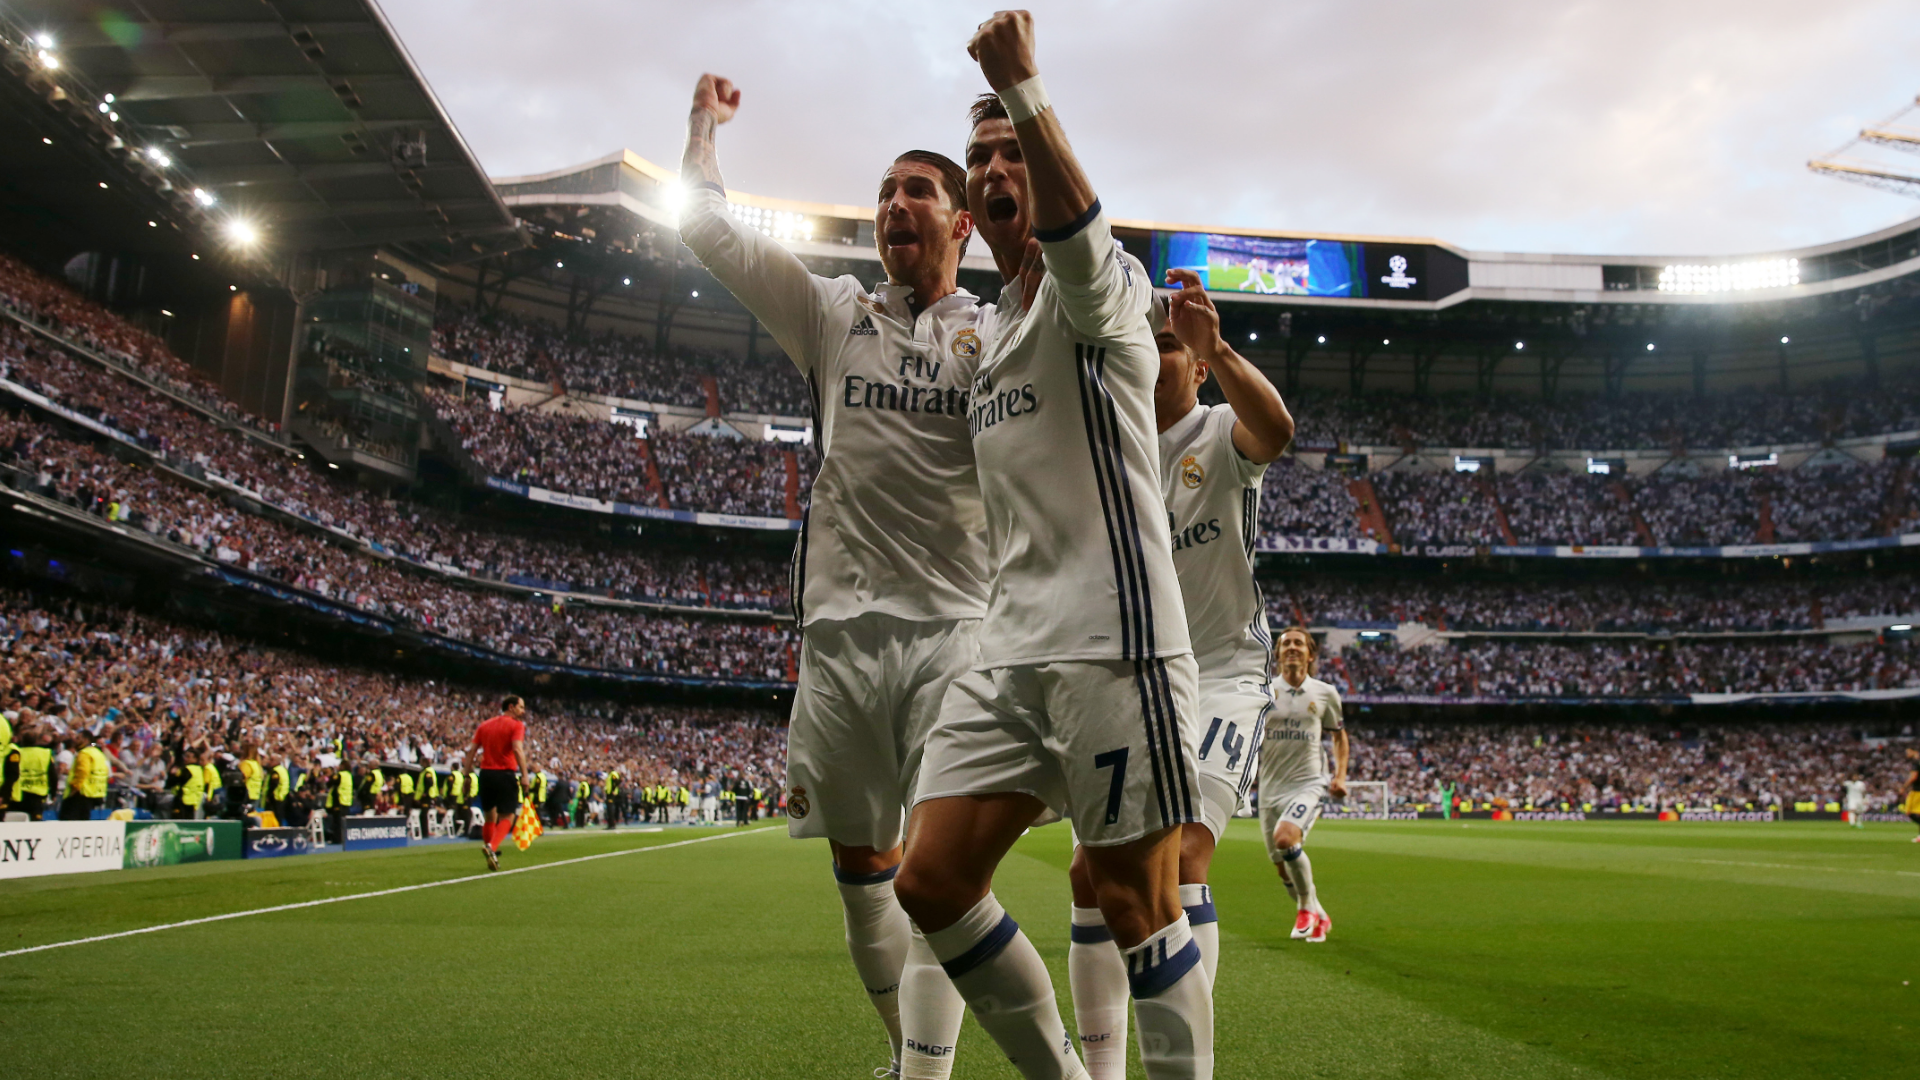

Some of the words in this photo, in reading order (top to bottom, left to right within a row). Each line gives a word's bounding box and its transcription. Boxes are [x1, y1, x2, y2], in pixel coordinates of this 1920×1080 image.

[850, 326, 879, 336] adidas
[900, 356, 941, 383] Fly
[630, 505, 647, 516] Real
[648, 508, 675, 519] Madrid
[1267, 728, 1315, 741] Emirates
[1199, 717, 1244, 771] 14
[1095, 747, 1129, 825] 7
[1285, 802, 1307, 819] 19
[1322, 811, 1419, 820] masterard
[1514, 810, 1586, 821] priceless
[1681, 811, 1774, 822] mastercard
[0, 838, 41, 862] NY
[56, 836, 121, 859] XPERIA
[867, 983, 900, 995] RMC
[1080, 1033, 1111, 1043] MCF
[907, 1038, 953, 1056] RMCF
